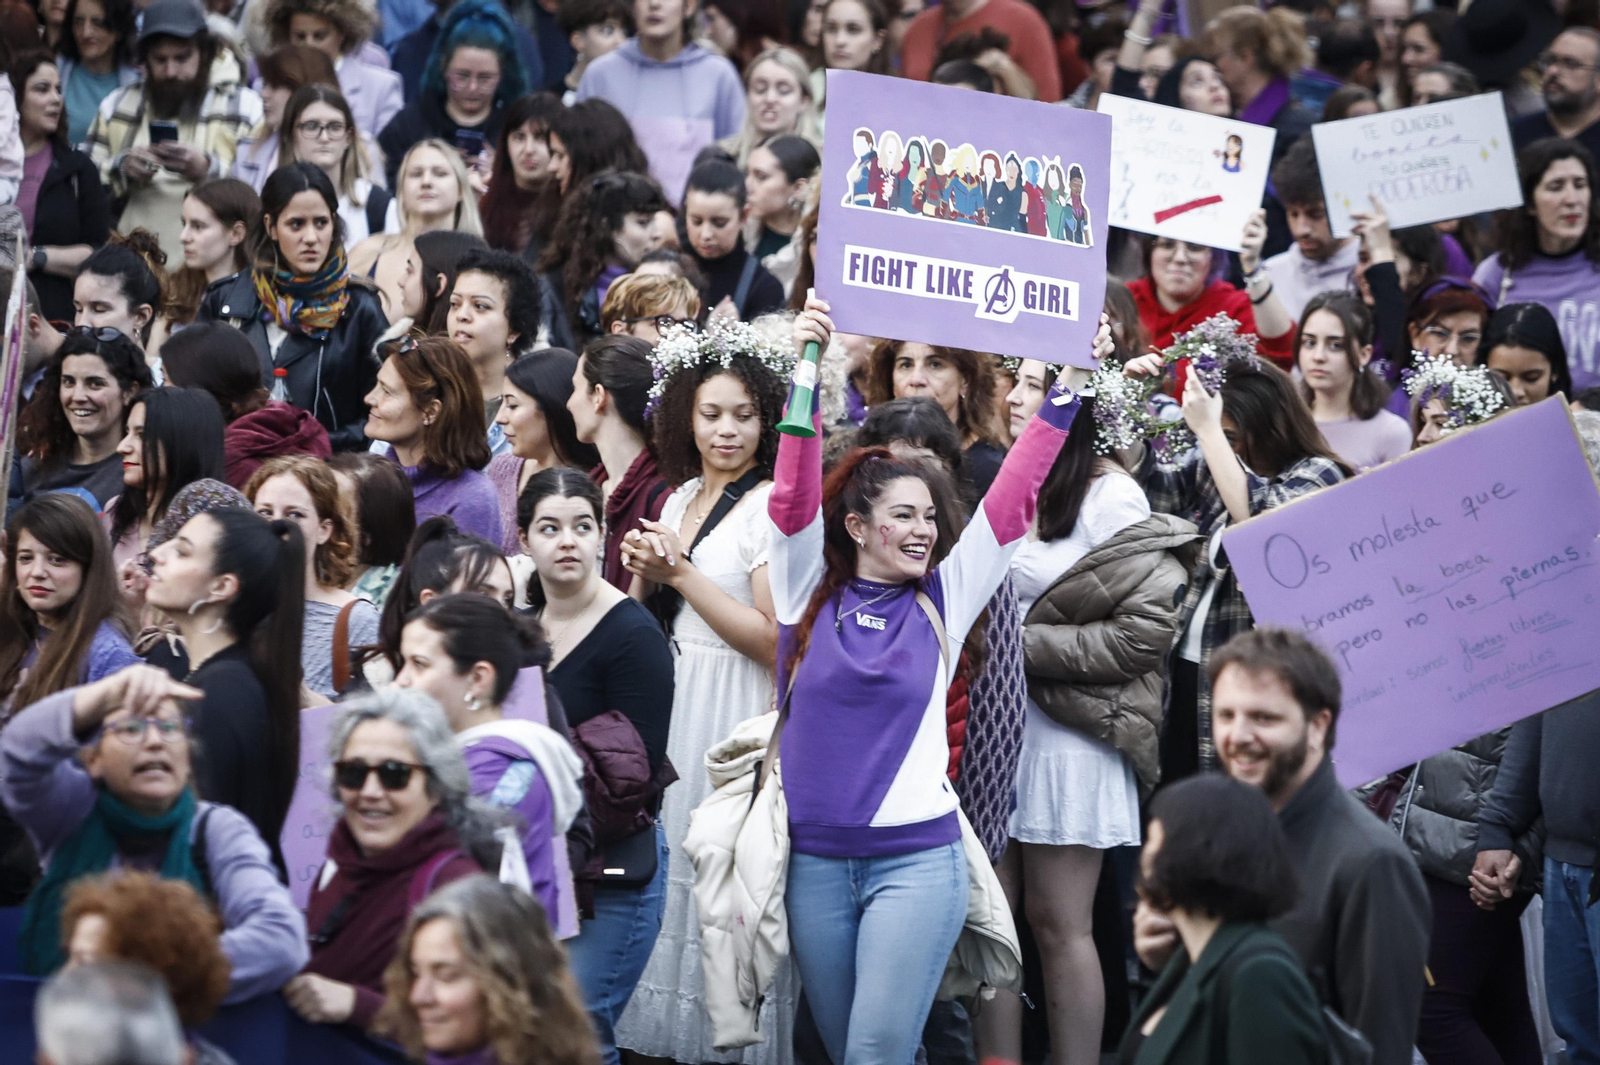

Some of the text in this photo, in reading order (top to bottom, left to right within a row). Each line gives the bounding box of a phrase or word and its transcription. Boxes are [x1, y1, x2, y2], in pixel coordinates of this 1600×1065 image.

[1359, 122, 1381, 140] TE
[849, 252, 917, 290] FIGHT
[926, 264, 974, 299] LIKE
[1023, 280, 1071, 316] GIRL
[1264, 482, 1518, 589] Os molesta que
[856, 612, 887, 631] VANS
[1301, 555, 1493, 632] bramos la boca
[1509, 611, 1556, 634] libres
[1335, 627, 1382, 673] pero
[1405, 612, 1428, 629] no
[1446, 594, 1477, 611] las
